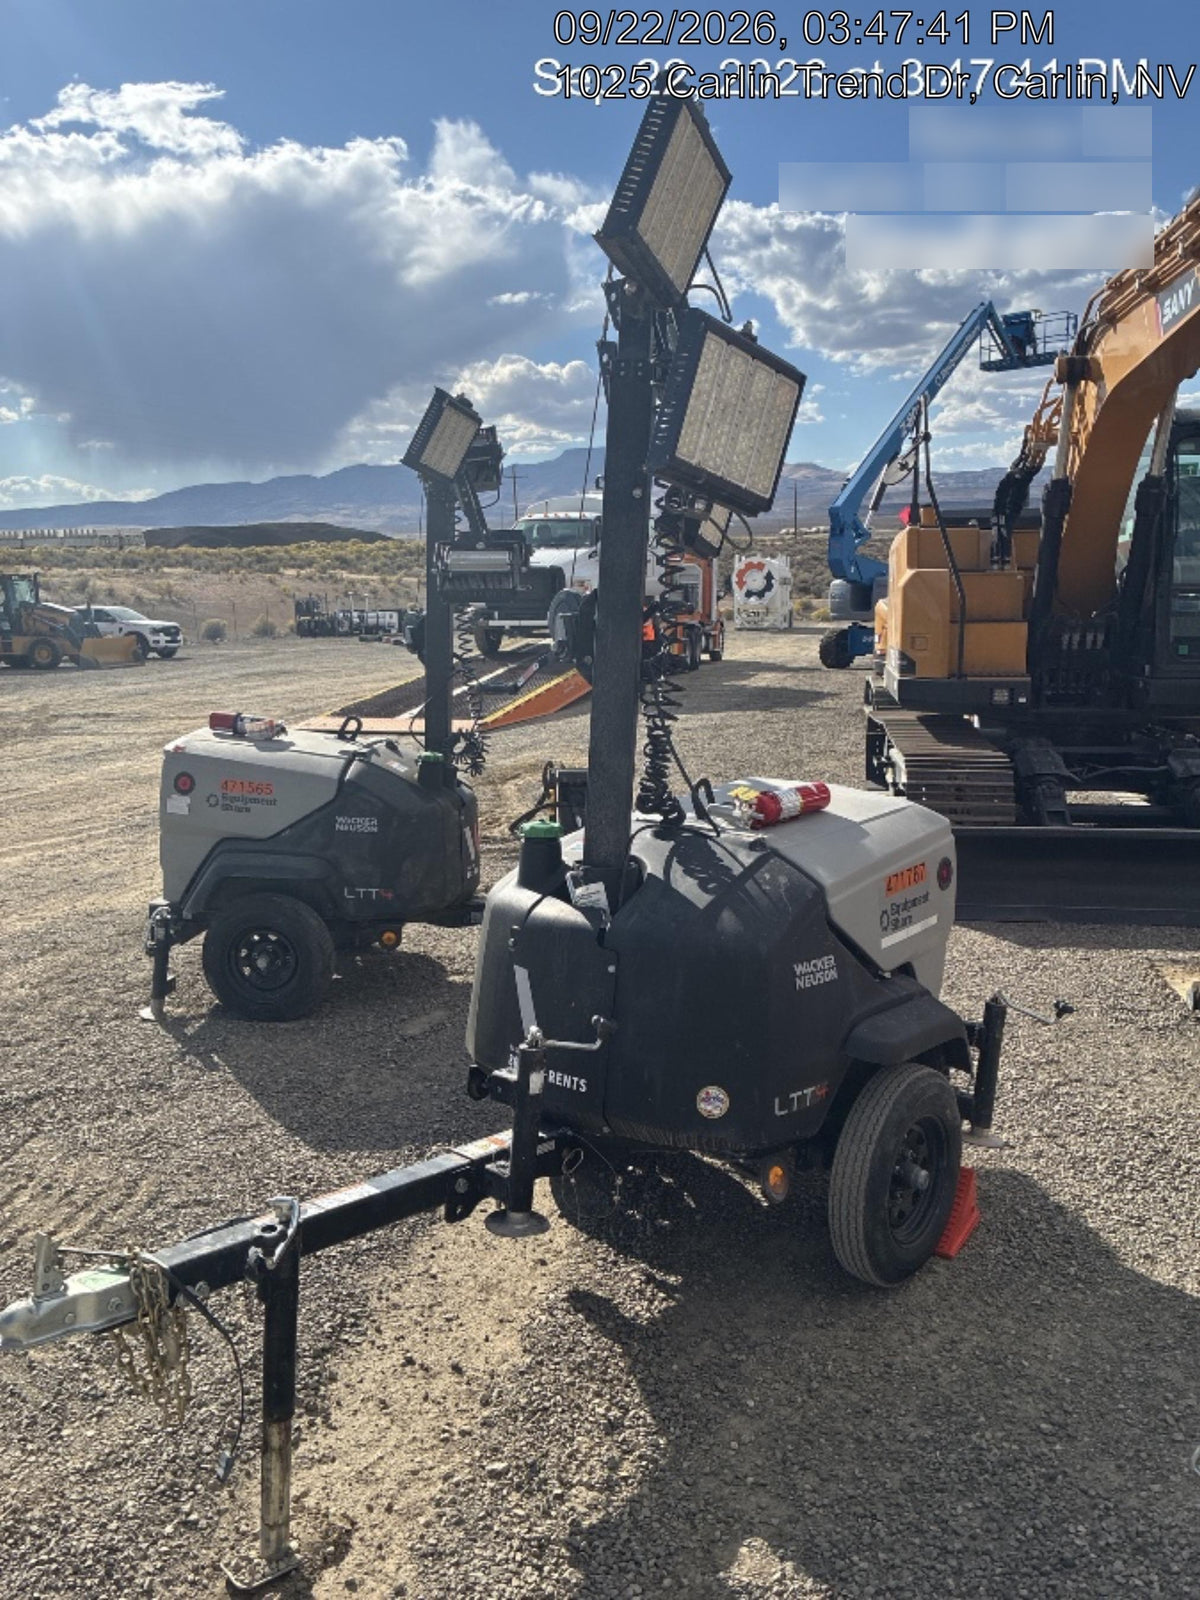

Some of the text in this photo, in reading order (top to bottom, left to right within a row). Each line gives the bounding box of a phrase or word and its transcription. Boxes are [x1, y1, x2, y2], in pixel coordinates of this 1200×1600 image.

[1162, 276, 1196, 325] SANY
[221, 779, 275, 796] 471565
[885, 862, 926, 892] 471767
[344, 886, 393, 900] LTT4
[793, 954, 837, 976] WACKER
[795, 966, 838, 991] NEUSON
